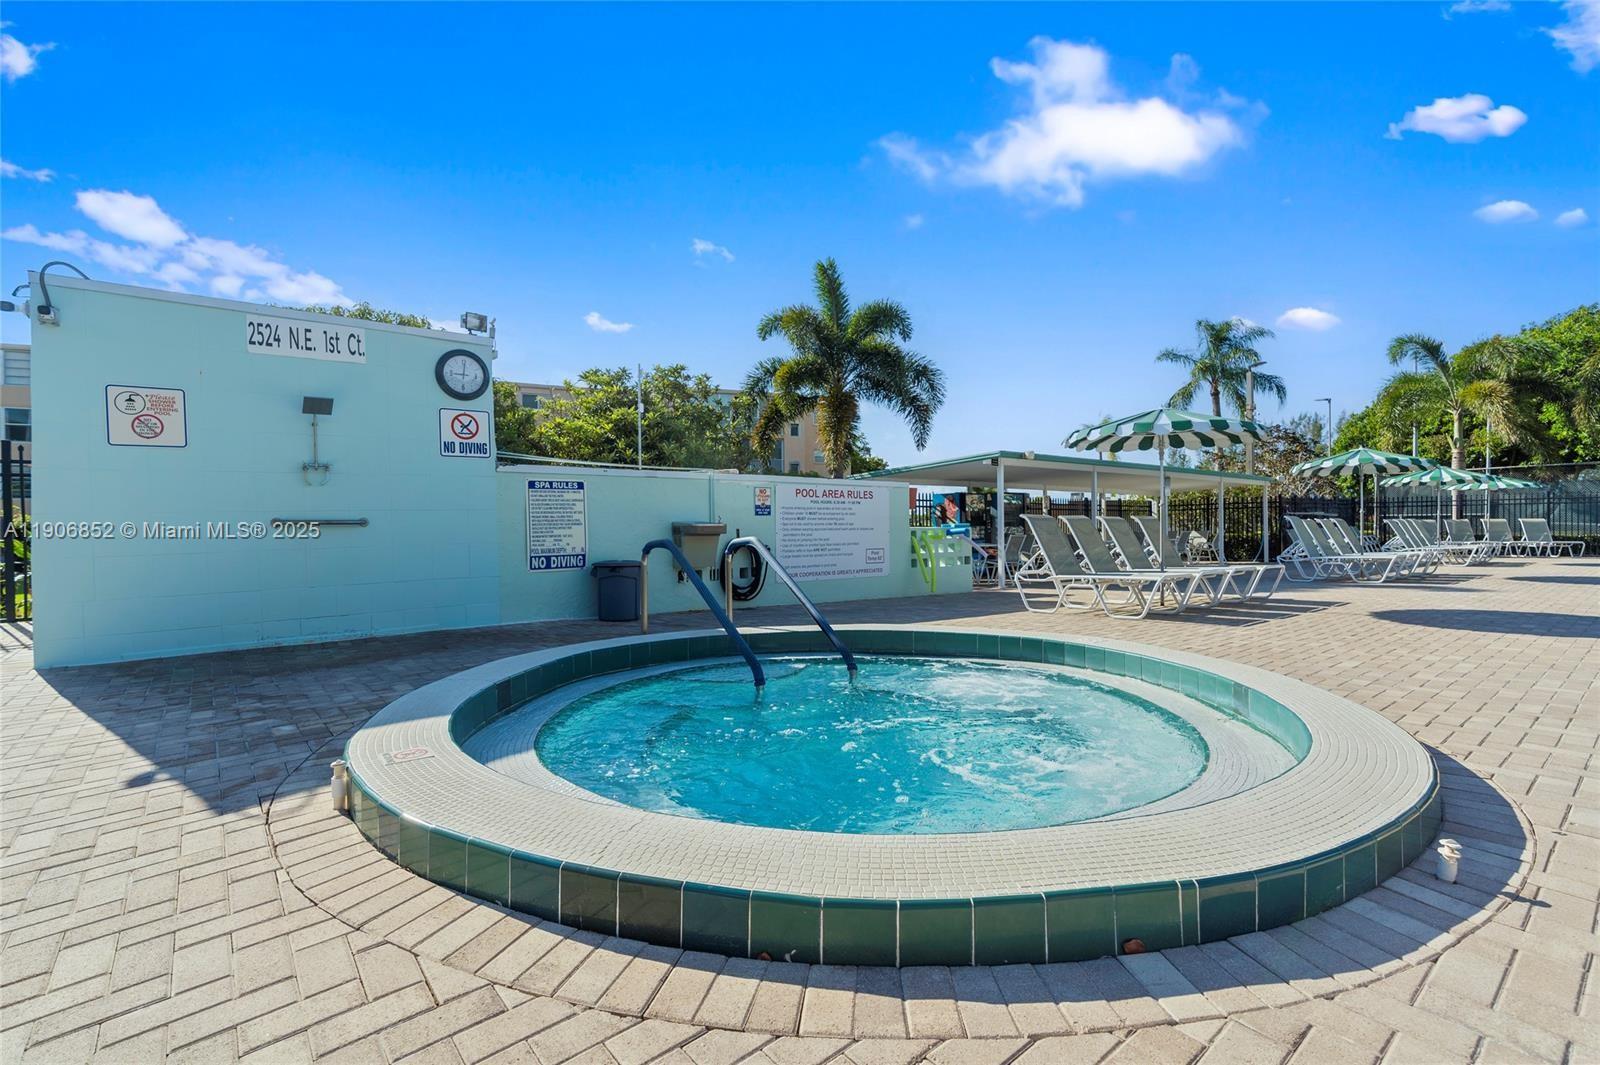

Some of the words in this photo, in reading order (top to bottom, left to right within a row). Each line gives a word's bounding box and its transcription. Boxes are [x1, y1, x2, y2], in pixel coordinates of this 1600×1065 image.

[248, 321, 281, 348] 2524
[289, 326, 316, 352] N.E.
[323, 330, 341, 354] 1st
[347, 333, 366, 357] Ct.
[444, 441, 455, 453] NO
[459, 442, 488, 455] DIVING
[552, 481, 578, 489] RULES
[795, 488, 820, 498] POOL
[821, 489, 846, 499] AREA
[847, 490, 874, 499] RULES
[531, 556, 546, 569] NO
[551, 555, 584, 568] DIVING
